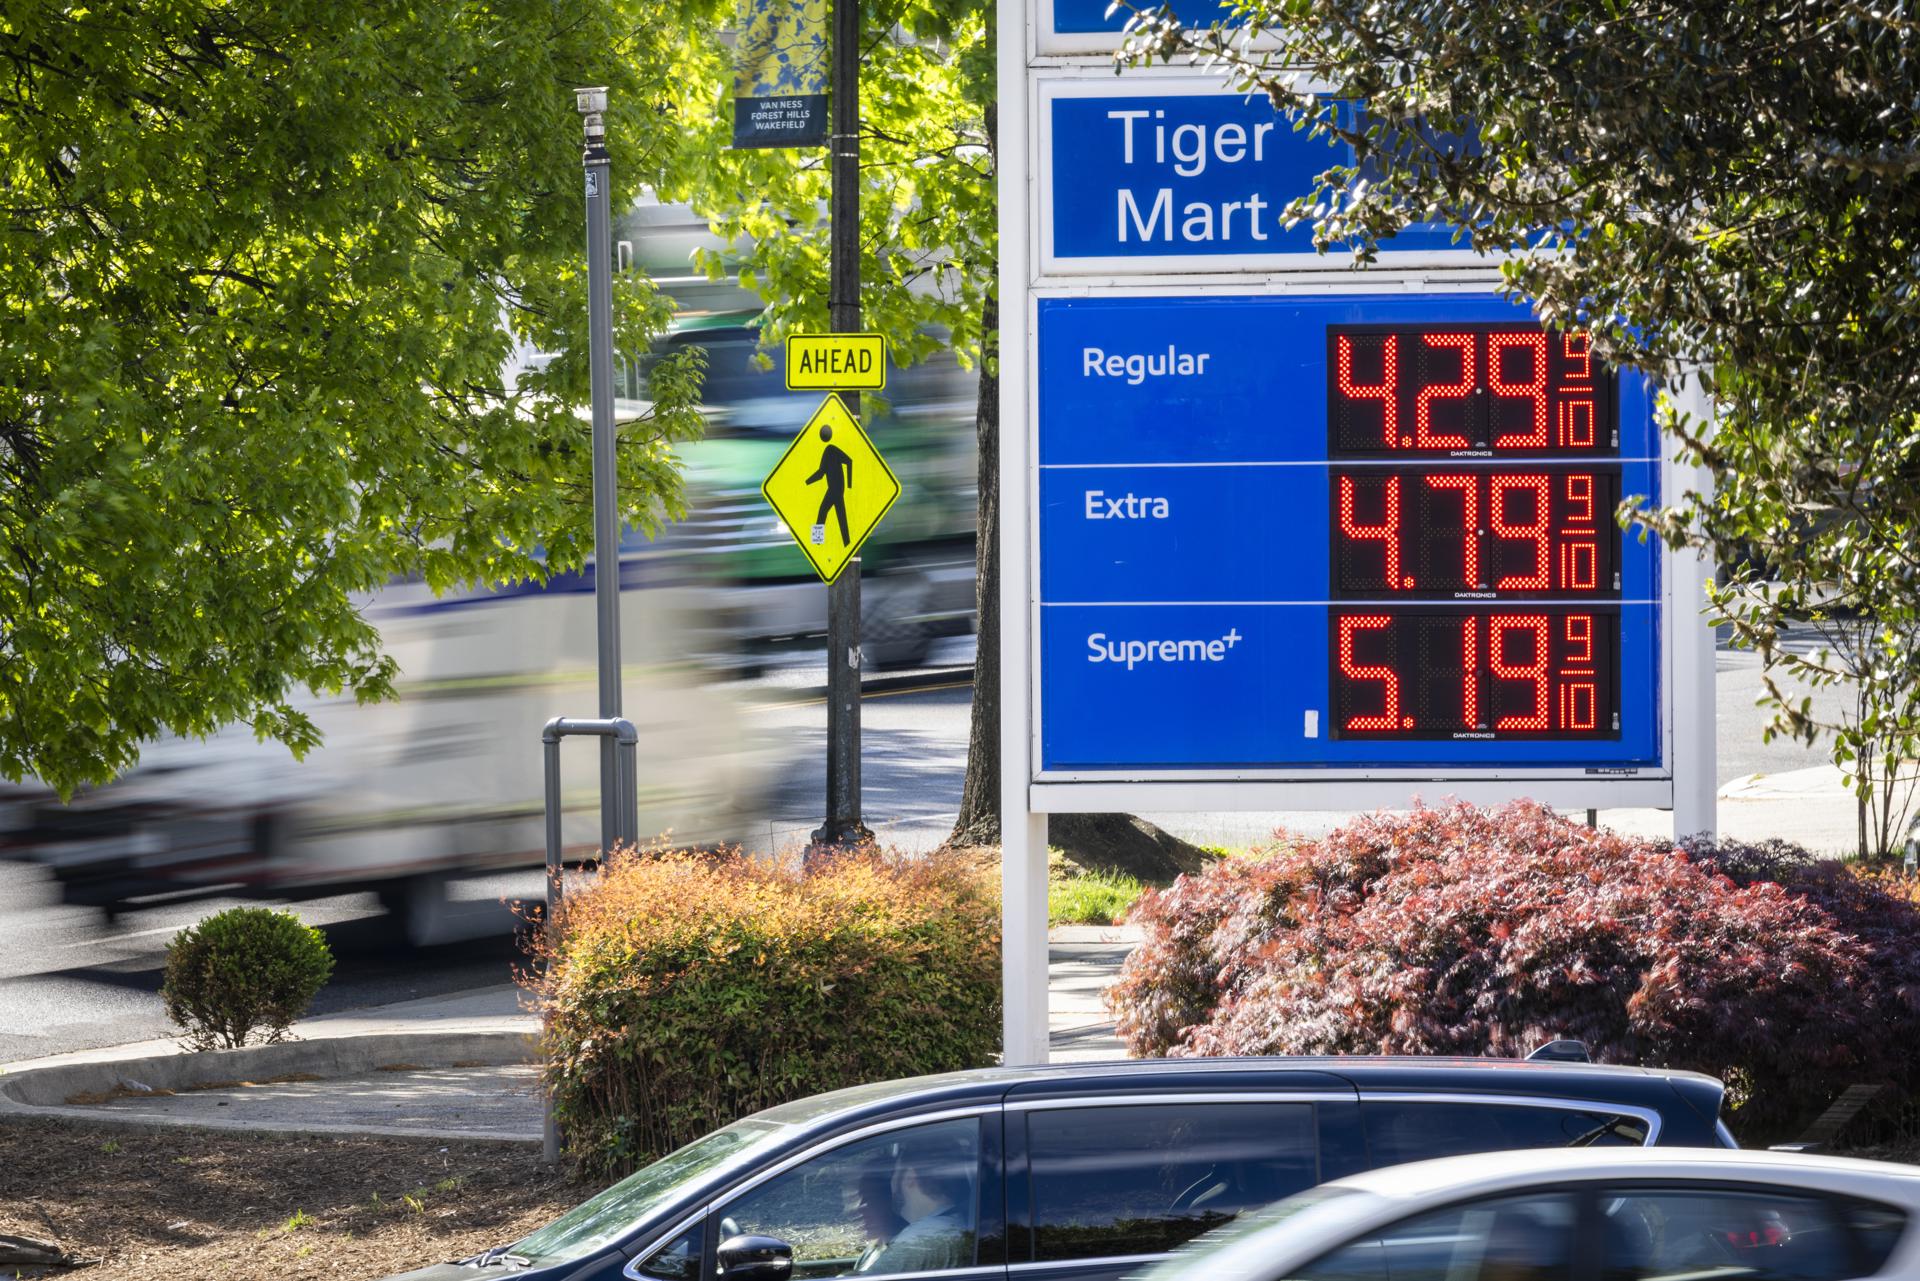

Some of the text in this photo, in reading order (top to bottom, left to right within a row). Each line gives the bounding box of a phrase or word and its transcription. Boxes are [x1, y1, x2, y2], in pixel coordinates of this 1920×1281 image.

[751, 110, 810, 120] FOREST HILLS
[755, 120, 805, 130] WAKEFIELD
[760, 100, 803, 110] VAN NESS
[1107, 109, 1274, 177] Tiger
[1117, 187, 1268, 242] Mart
[799, 349, 872, 373] AHEAD
[1083, 344, 1210, 385] Regular
[1565, 333, 1591, 378] 9
[1338, 333, 1547, 448] 4.29
[1559, 400, 1594, 446] 10
[1085, 490, 1169, 519] Extra
[1568, 475, 1592, 520] 9
[1340, 475, 1549, 589] 4.79
[1561, 543, 1596, 588] 10
[1087, 628, 1242, 670] Supreme+
[1567, 616, 1591, 661] 9
[1340, 615, 1548, 729] 5.19
[1560, 683, 1595, 729] 10
